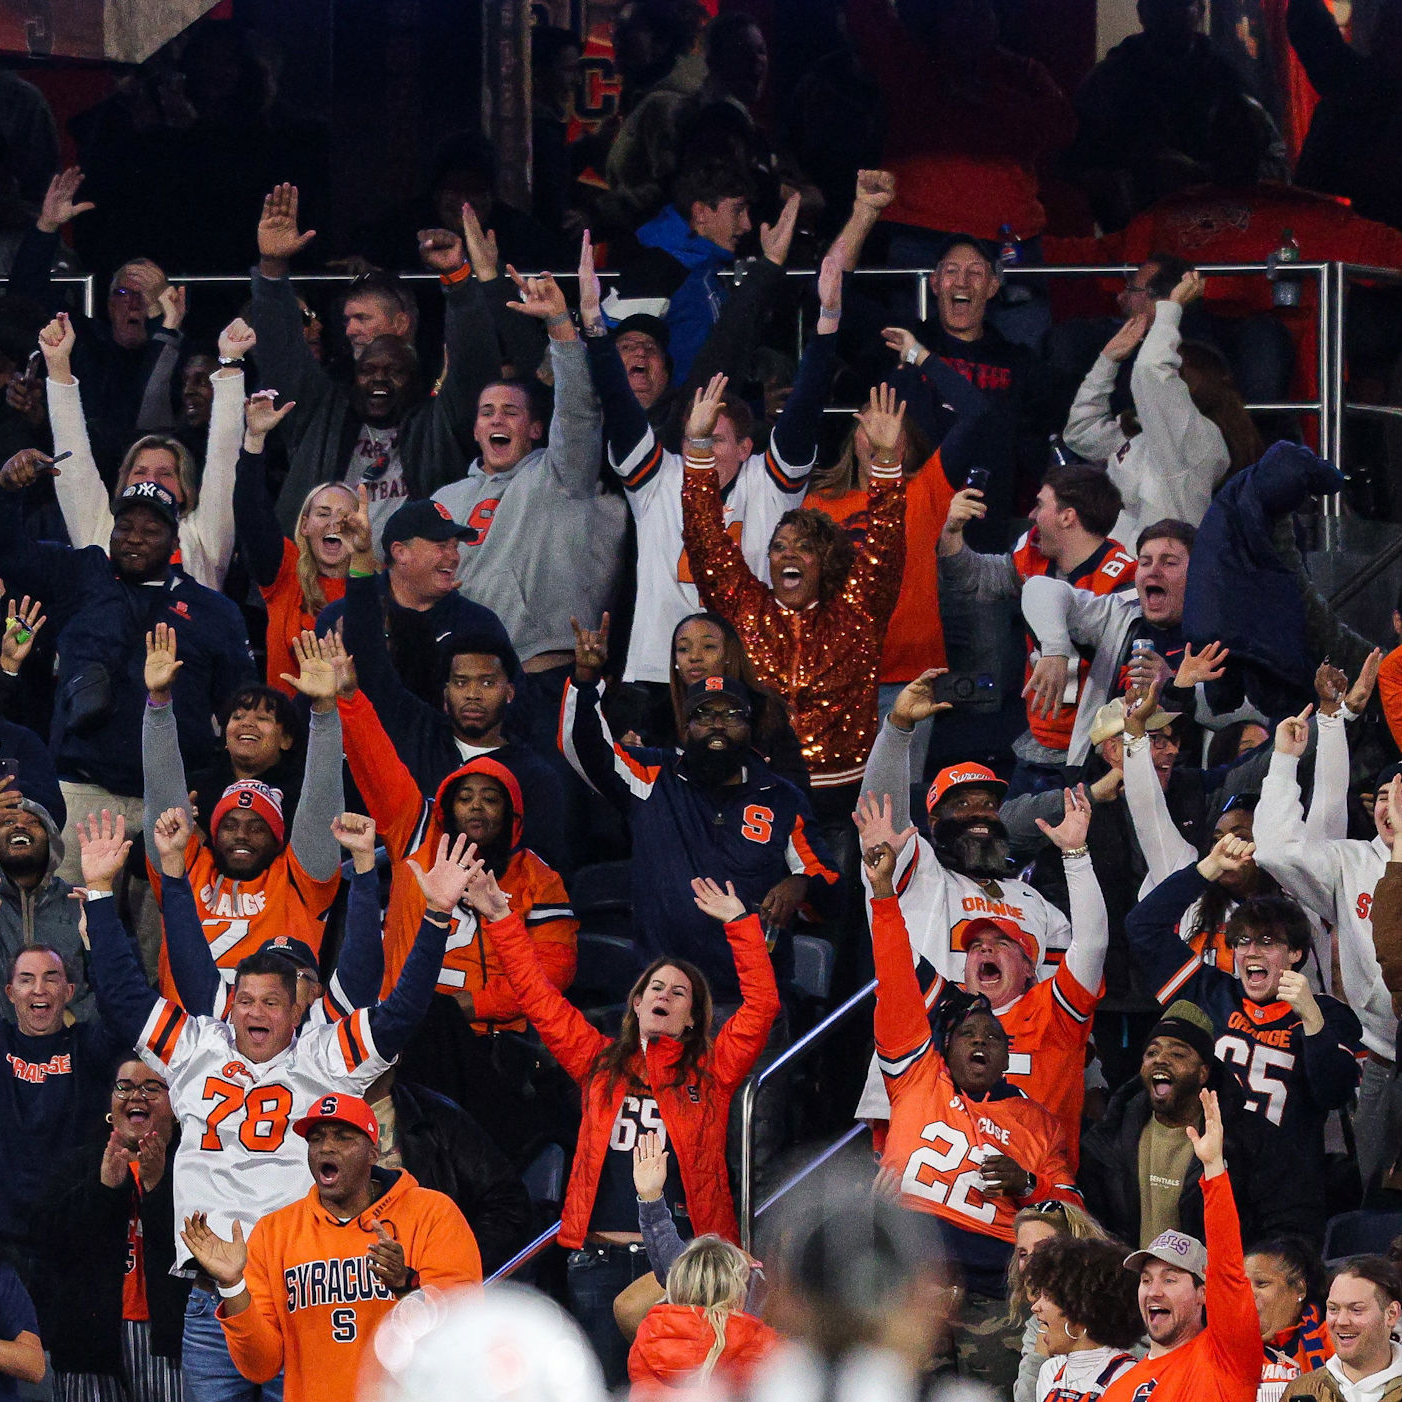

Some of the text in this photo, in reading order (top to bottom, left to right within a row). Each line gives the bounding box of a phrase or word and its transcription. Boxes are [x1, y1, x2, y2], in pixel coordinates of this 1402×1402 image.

[136, 481, 158, 497] NY
[1101, 551, 1138, 579] 81
[705, 675, 724, 692] S
[948, 769, 994, 784] Syracu
[236, 791, 254, 809] S
[740, 803, 775, 845] S
[960, 896, 1027, 922] ORANGE
[1356, 892, 1373, 920] S
[1226, 1010, 1294, 1049] ORANGE
[5, 1052, 73, 1085] RACSE
[199, 1075, 294, 1153] 78
[319, 1095, 340, 1117] S
[948, 1093, 1012, 1147] SYCUSE
[609, 1095, 667, 1152] 65
[901, 1119, 997, 1226] 22
[1149, 1174, 1181, 1187] SENTIALS
[284, 1255, 397, 1314] SYRACU
[330, 1308, 358, 1343] S
